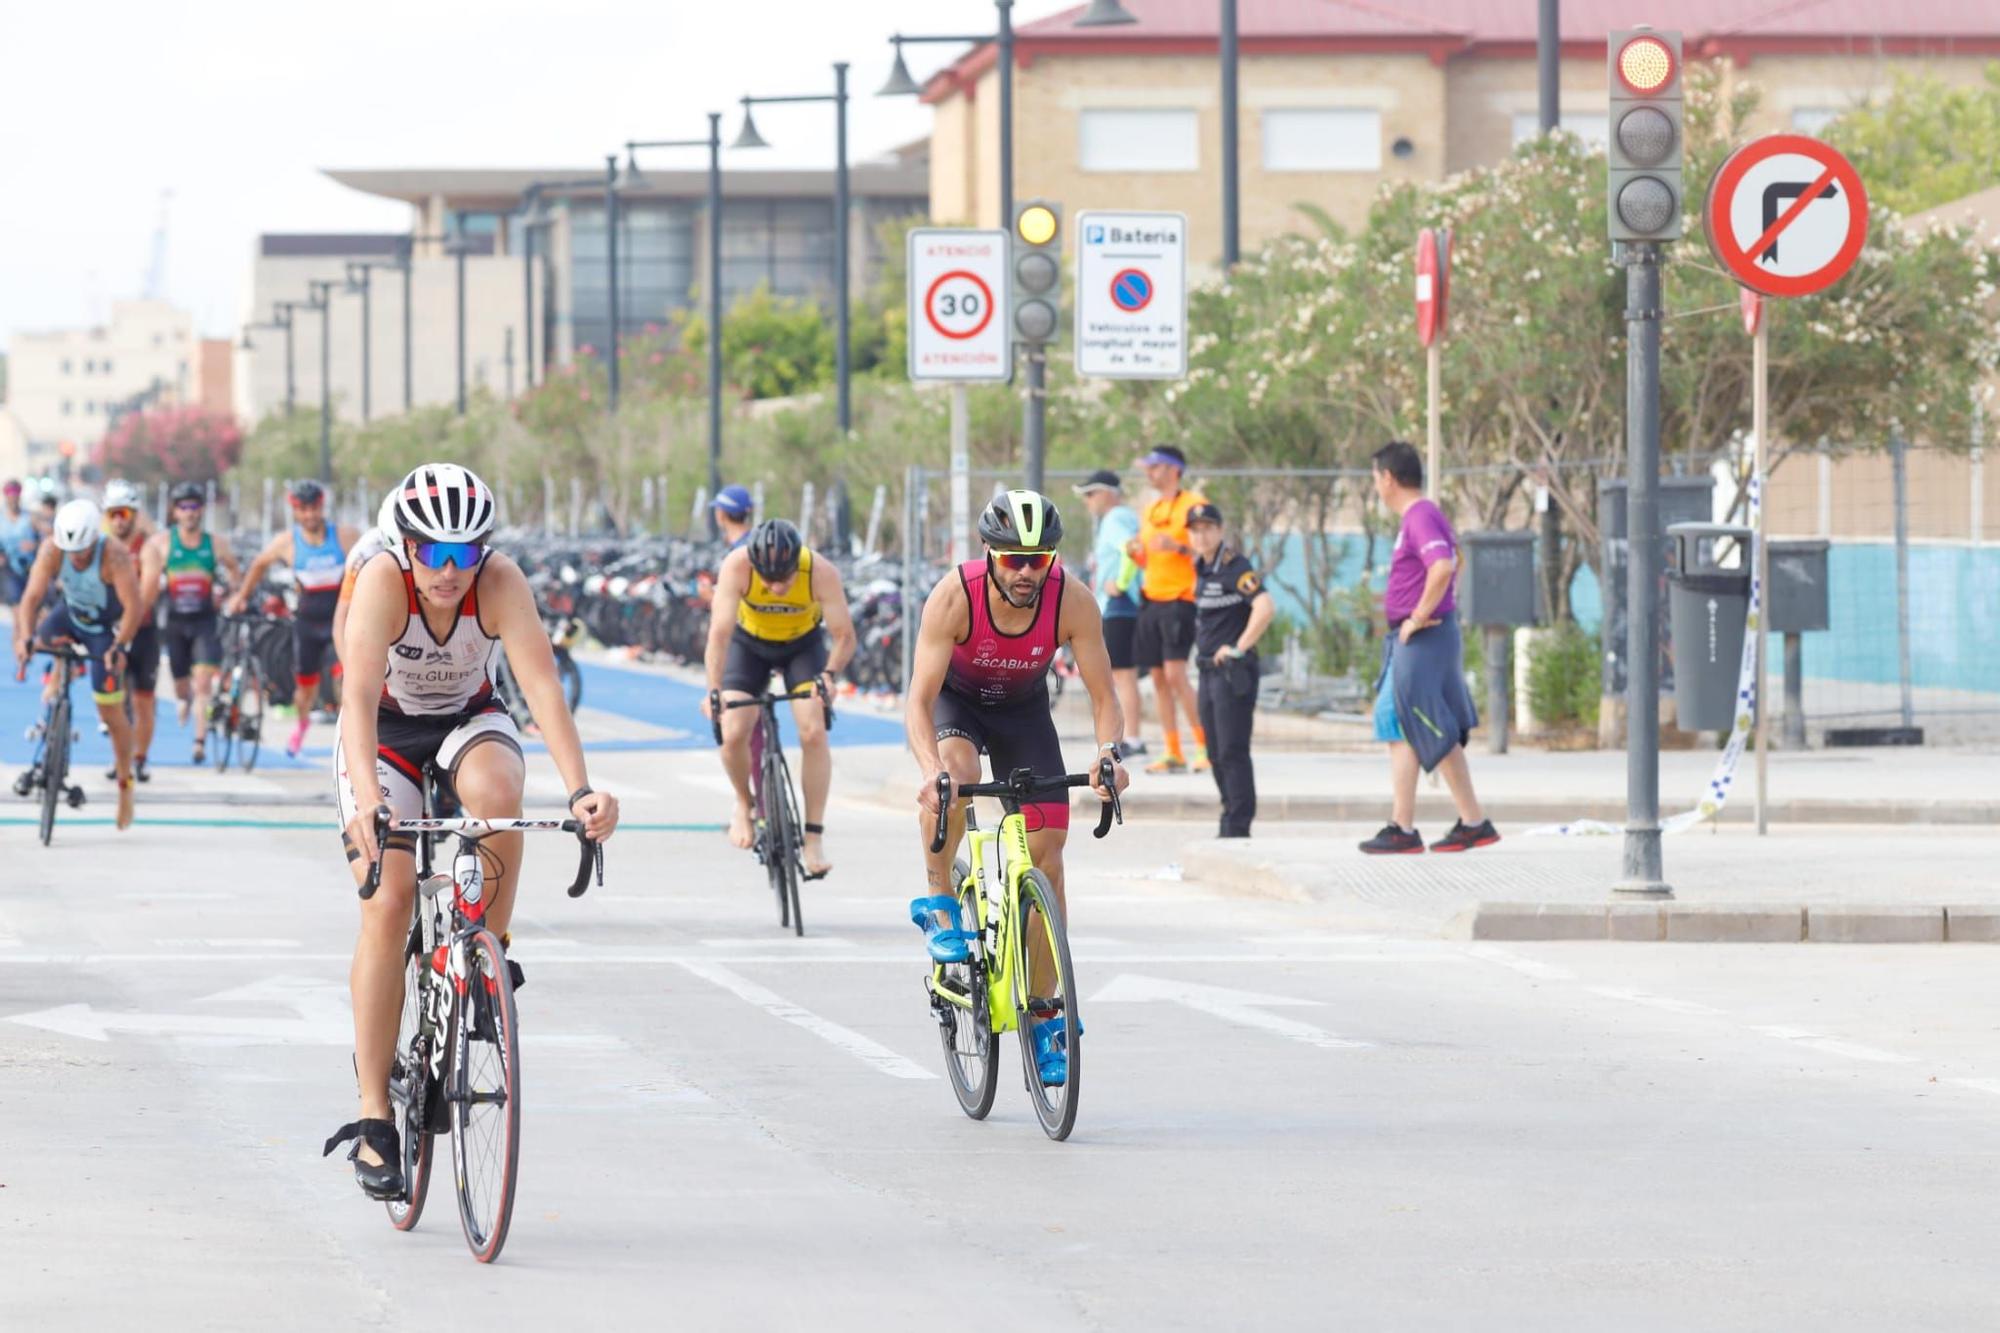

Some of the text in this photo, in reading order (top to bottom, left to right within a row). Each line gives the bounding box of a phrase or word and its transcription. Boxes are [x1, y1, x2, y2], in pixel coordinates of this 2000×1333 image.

[941, 294, 979, 316] 30
[1160, 323, 1173, 333] de
[972, 657, 1040, 670] ESCABIAS
